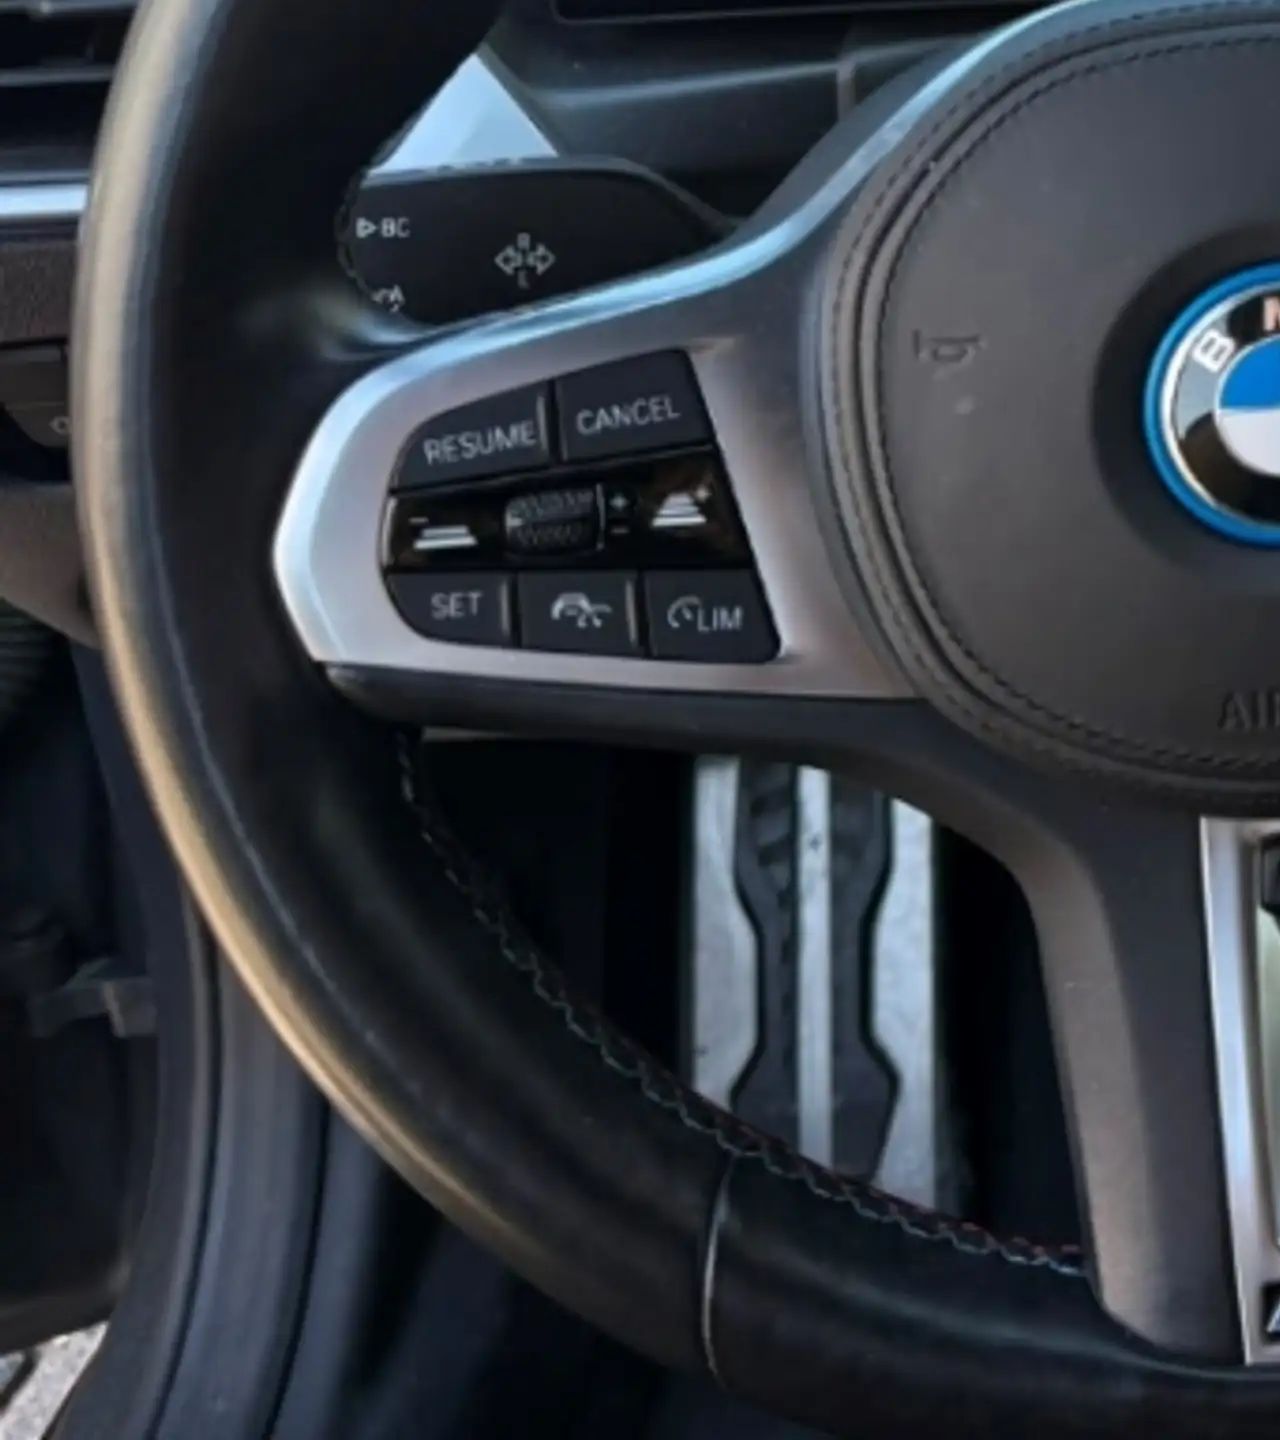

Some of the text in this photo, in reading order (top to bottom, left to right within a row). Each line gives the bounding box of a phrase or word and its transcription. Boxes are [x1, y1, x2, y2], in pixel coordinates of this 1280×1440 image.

[576, 396, 680, 436] CANCEL
[422, 420, 537, 464] RESUME
[430, 591, 482, 620] SET
[696, 606, 744, 632] LIM
